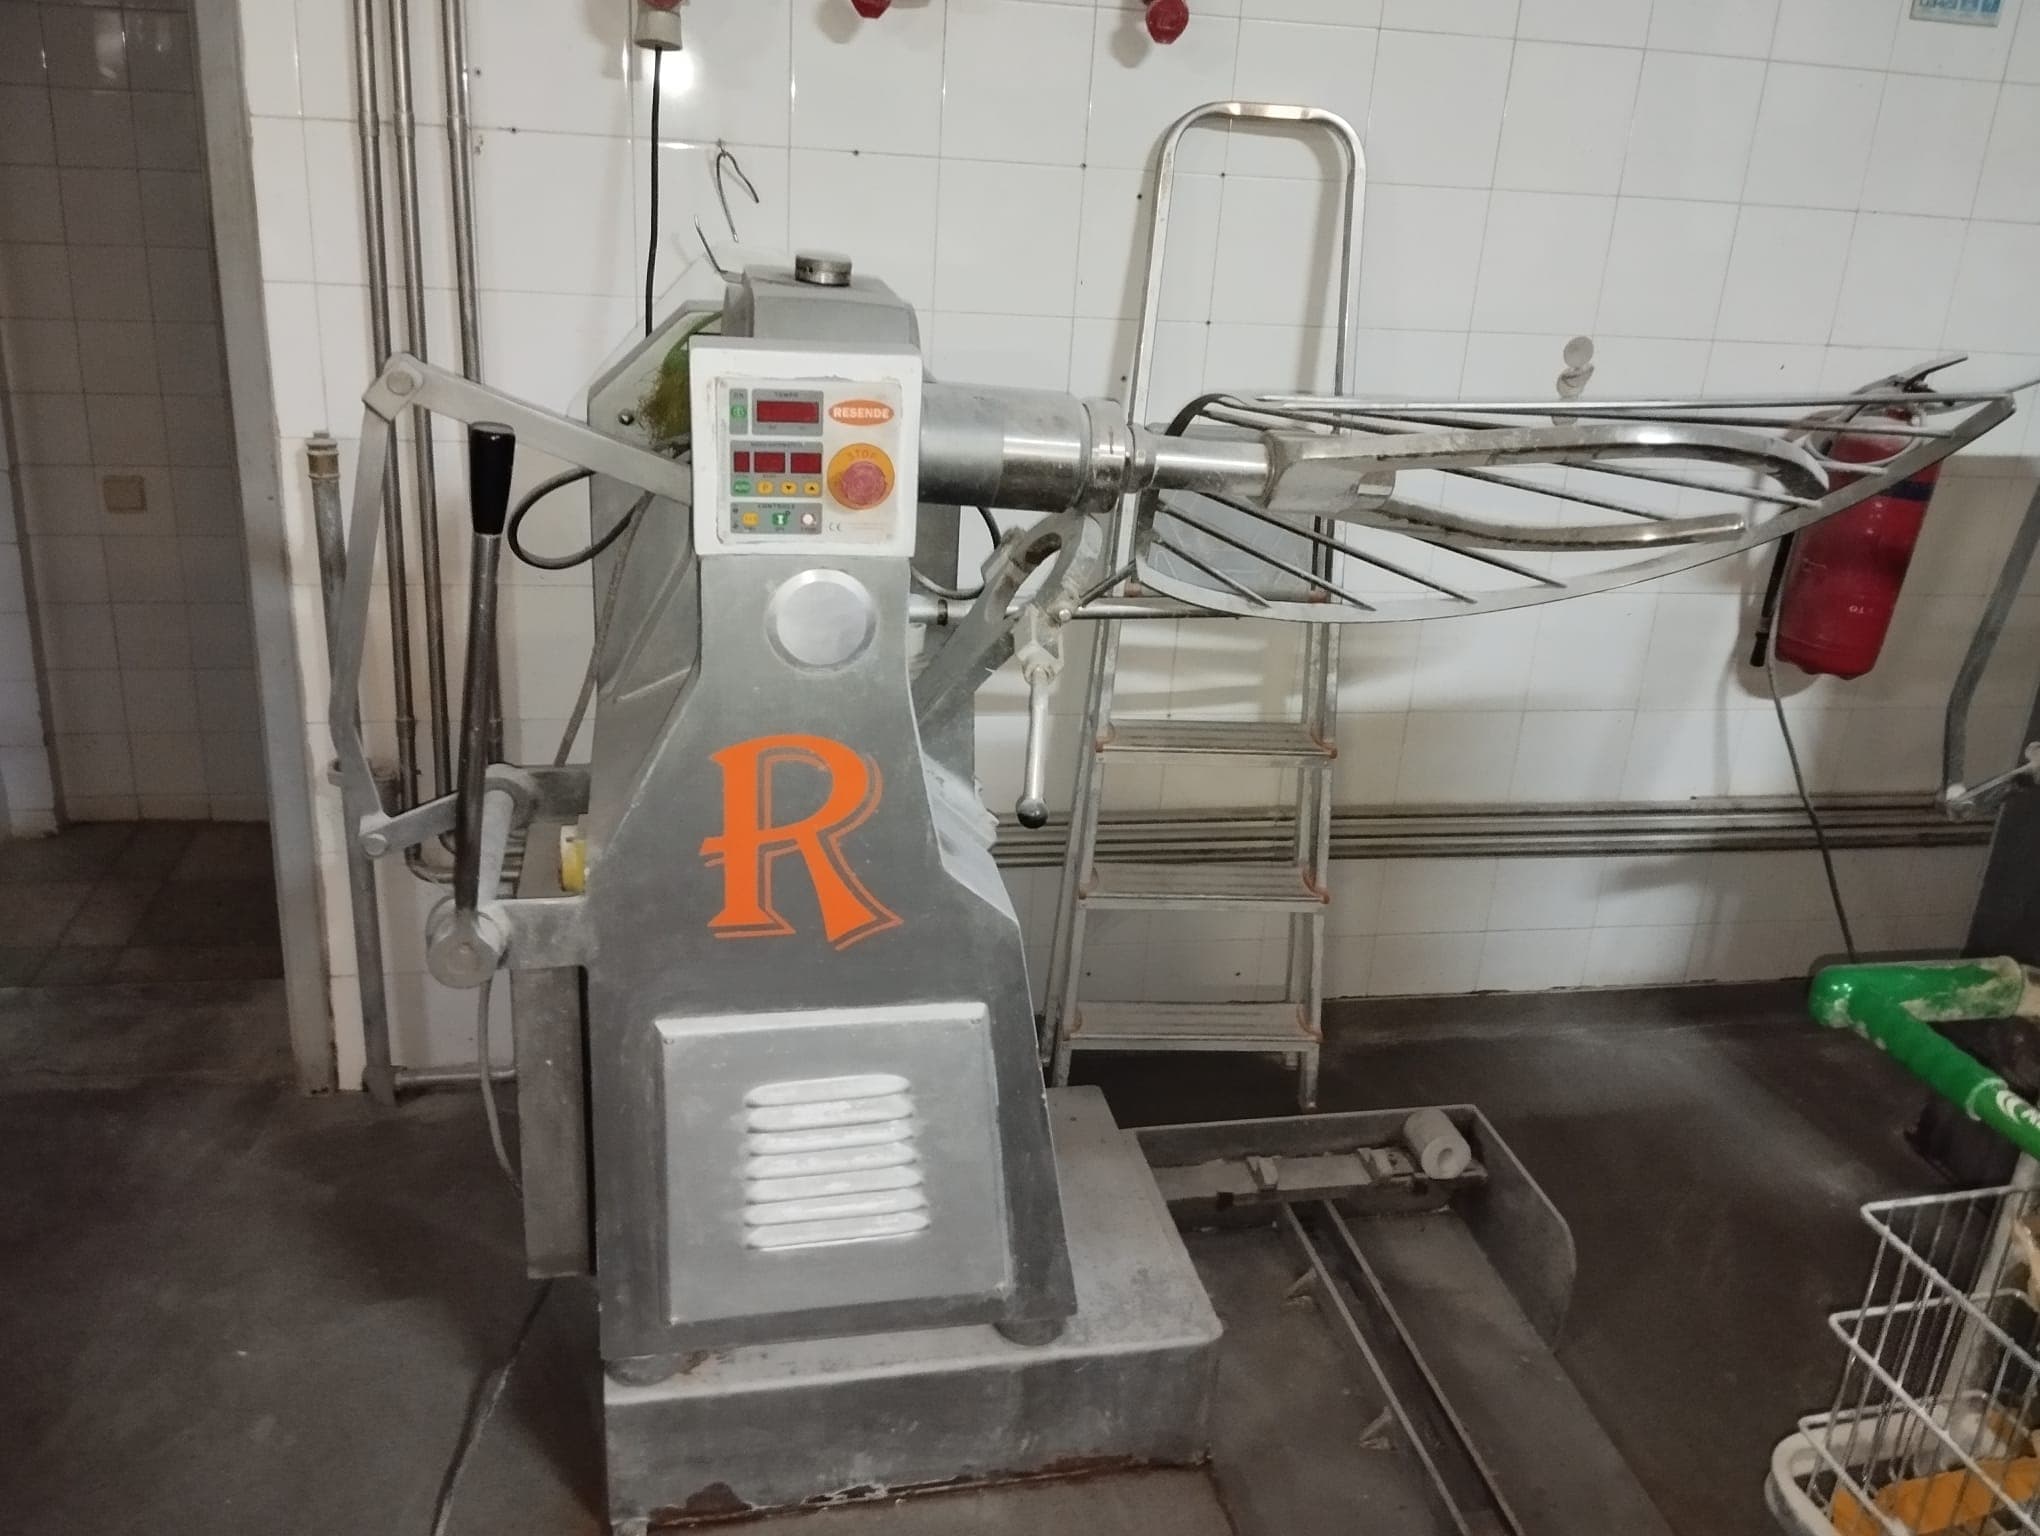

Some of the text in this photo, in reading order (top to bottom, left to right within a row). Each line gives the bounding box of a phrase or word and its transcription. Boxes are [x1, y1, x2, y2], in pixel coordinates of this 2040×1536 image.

[833, 407, 890, 419] RESENDE
[847, 448, 876, 460] STOP
[698, 732, 904, 951] R
